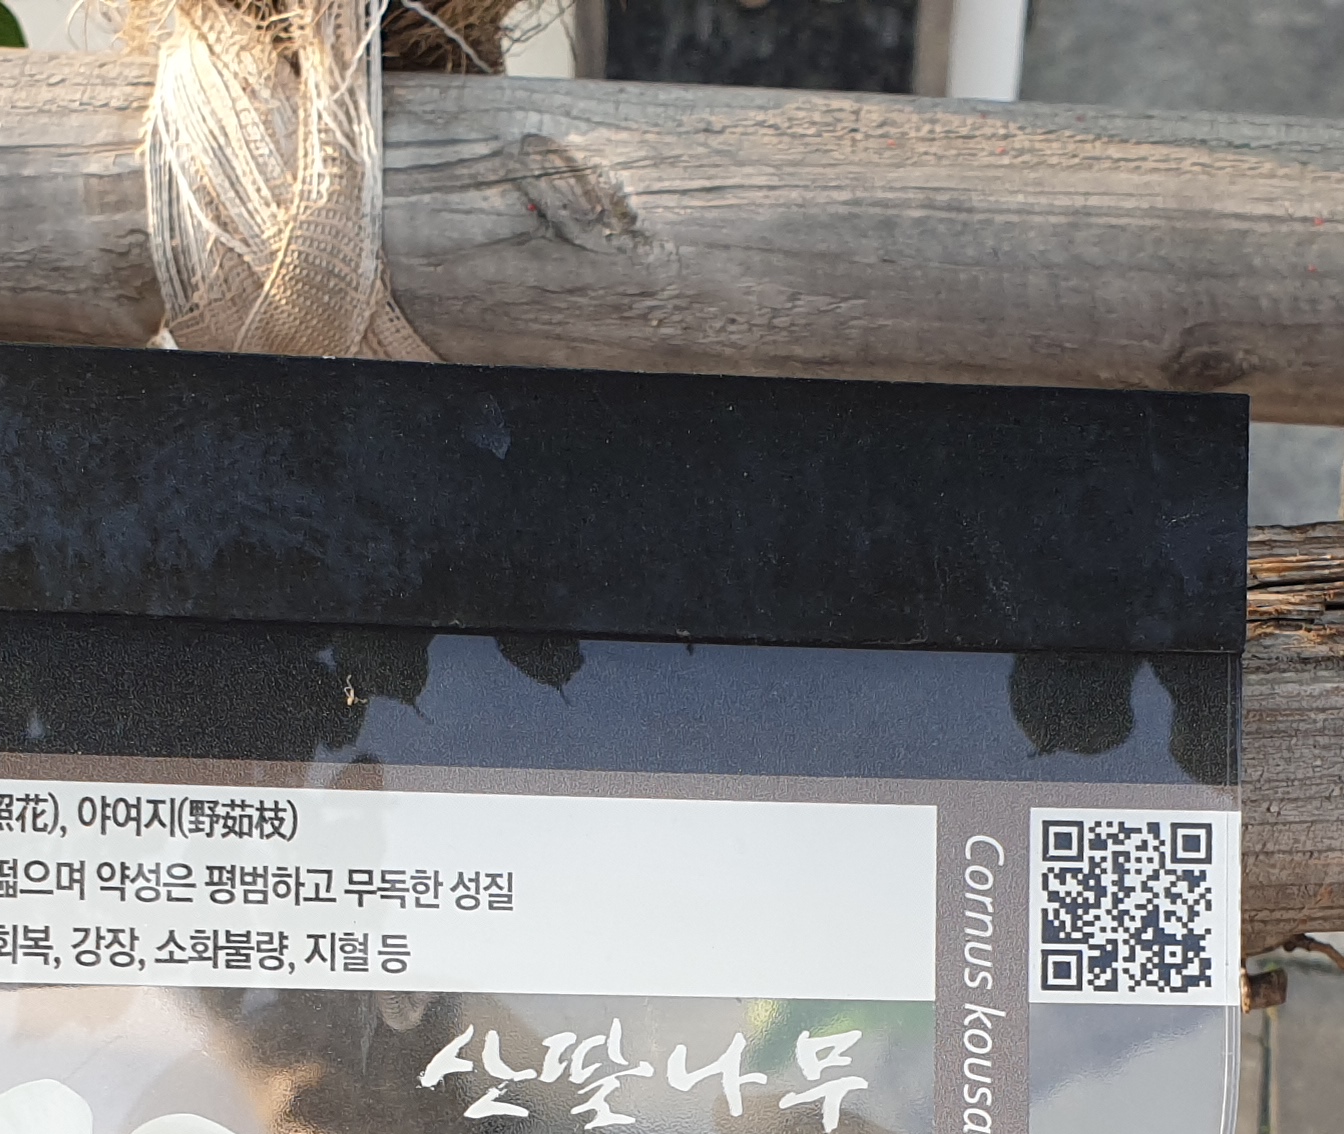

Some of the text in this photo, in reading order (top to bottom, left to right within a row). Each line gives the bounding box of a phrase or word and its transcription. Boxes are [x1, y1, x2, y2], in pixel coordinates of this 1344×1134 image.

[77, 795, 298, 842] 야여지(野茹枝)
[96, 861, 197, 903] 약성은
[205, 864, 337, 907] 평범하고
[343, 868, 444, 909] 무독한
[449, 870, 514, 911] 성질
[71, 926, 146, 971] 강장,
[154, 929, 296, 975] 소화불량,
[305, 932, 370, 973] 지혈
[377, 934, 412, 974] 등
[962, 834, 1006, 1134] Cornus kousa
[415, 1017, 869, 1134] 산딸나무
